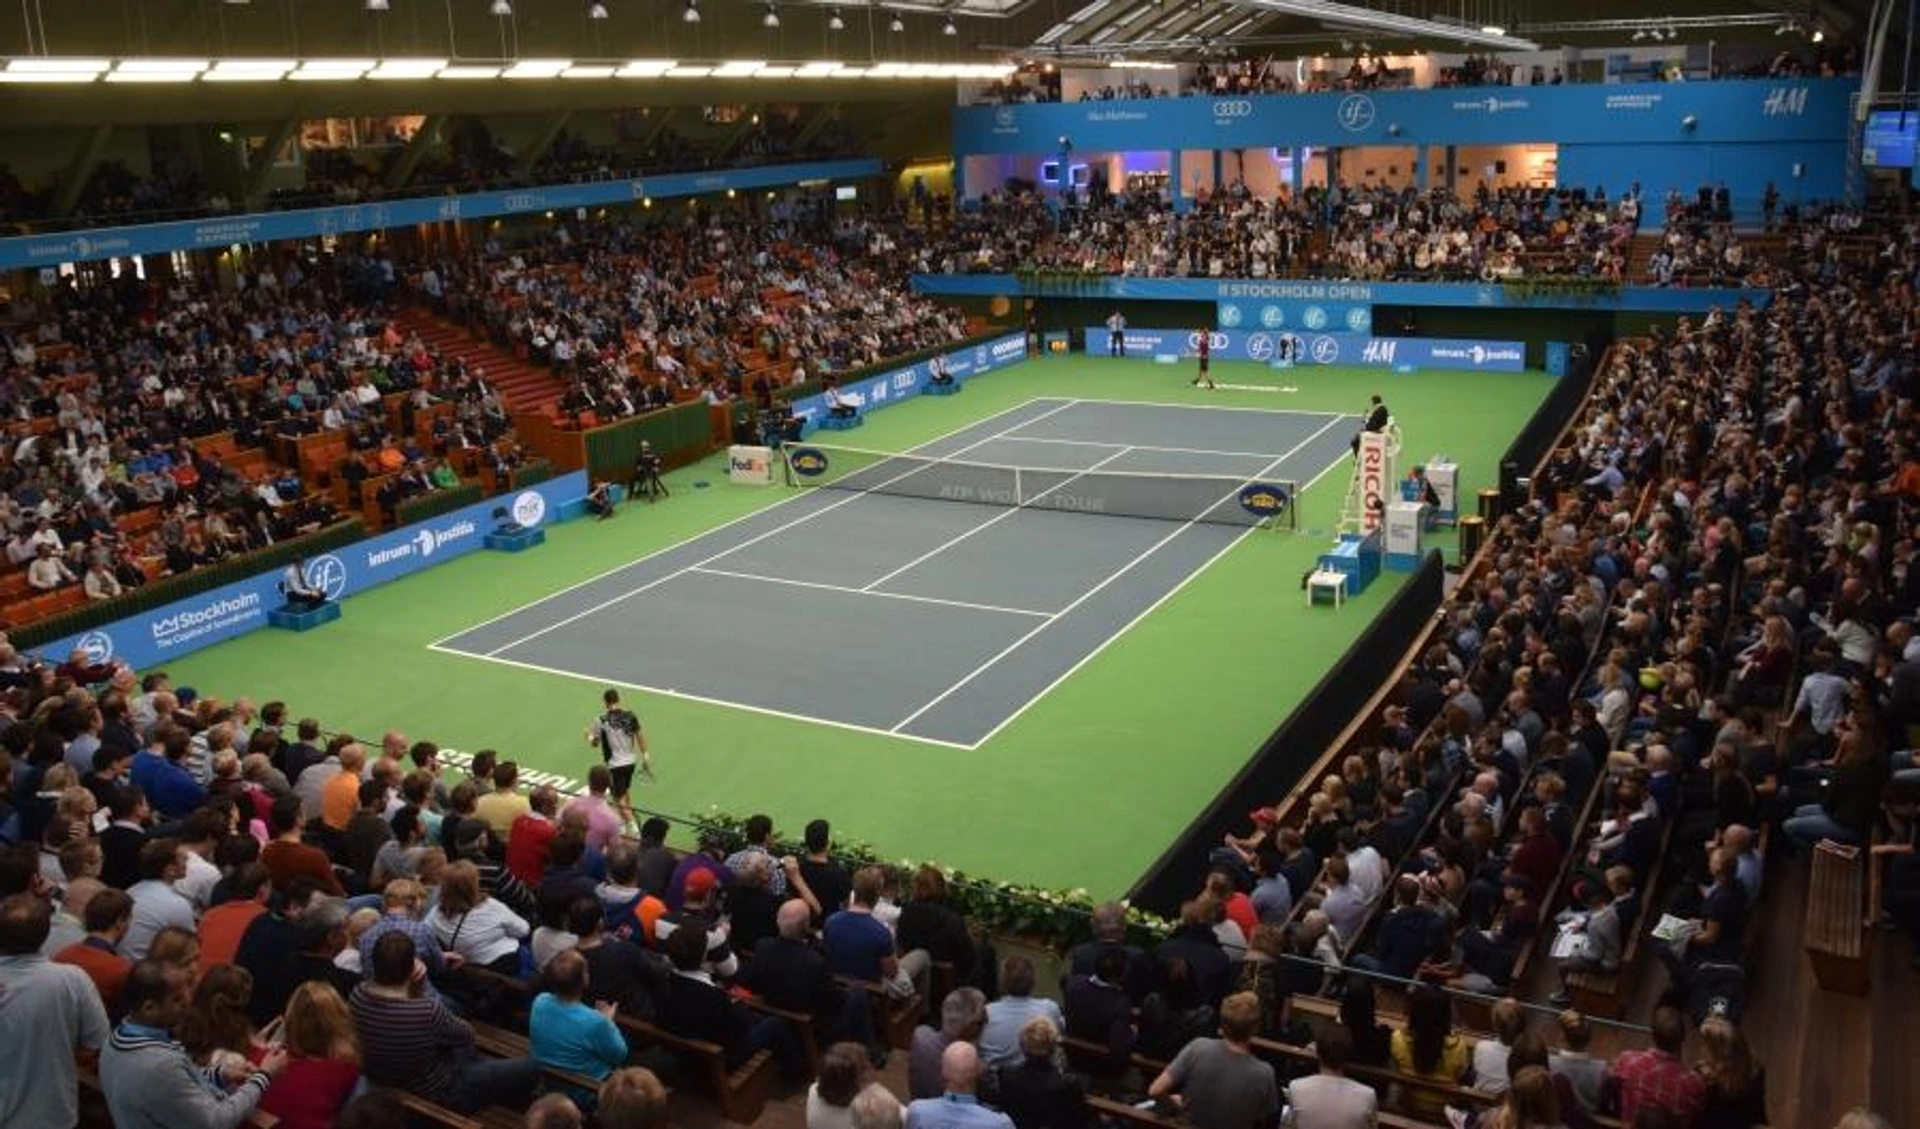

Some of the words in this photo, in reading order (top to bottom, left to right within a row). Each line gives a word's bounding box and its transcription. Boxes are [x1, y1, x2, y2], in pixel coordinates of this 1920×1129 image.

[1231, 283, 1325, 299] STOCKHOLM
[1328, 285, 1372, 300] OPEN
[976, 488, 1046, 506] WOD
[1054, 494, 1107, 512] TOUR
[1363, 445, 1383, 531] RICOH
[368, 542, 412, 567] intrum
[435, 519, 475, 549] justitia
[179, 593, 260, 629] Stockholm
[156, 638, 174, 649] The
